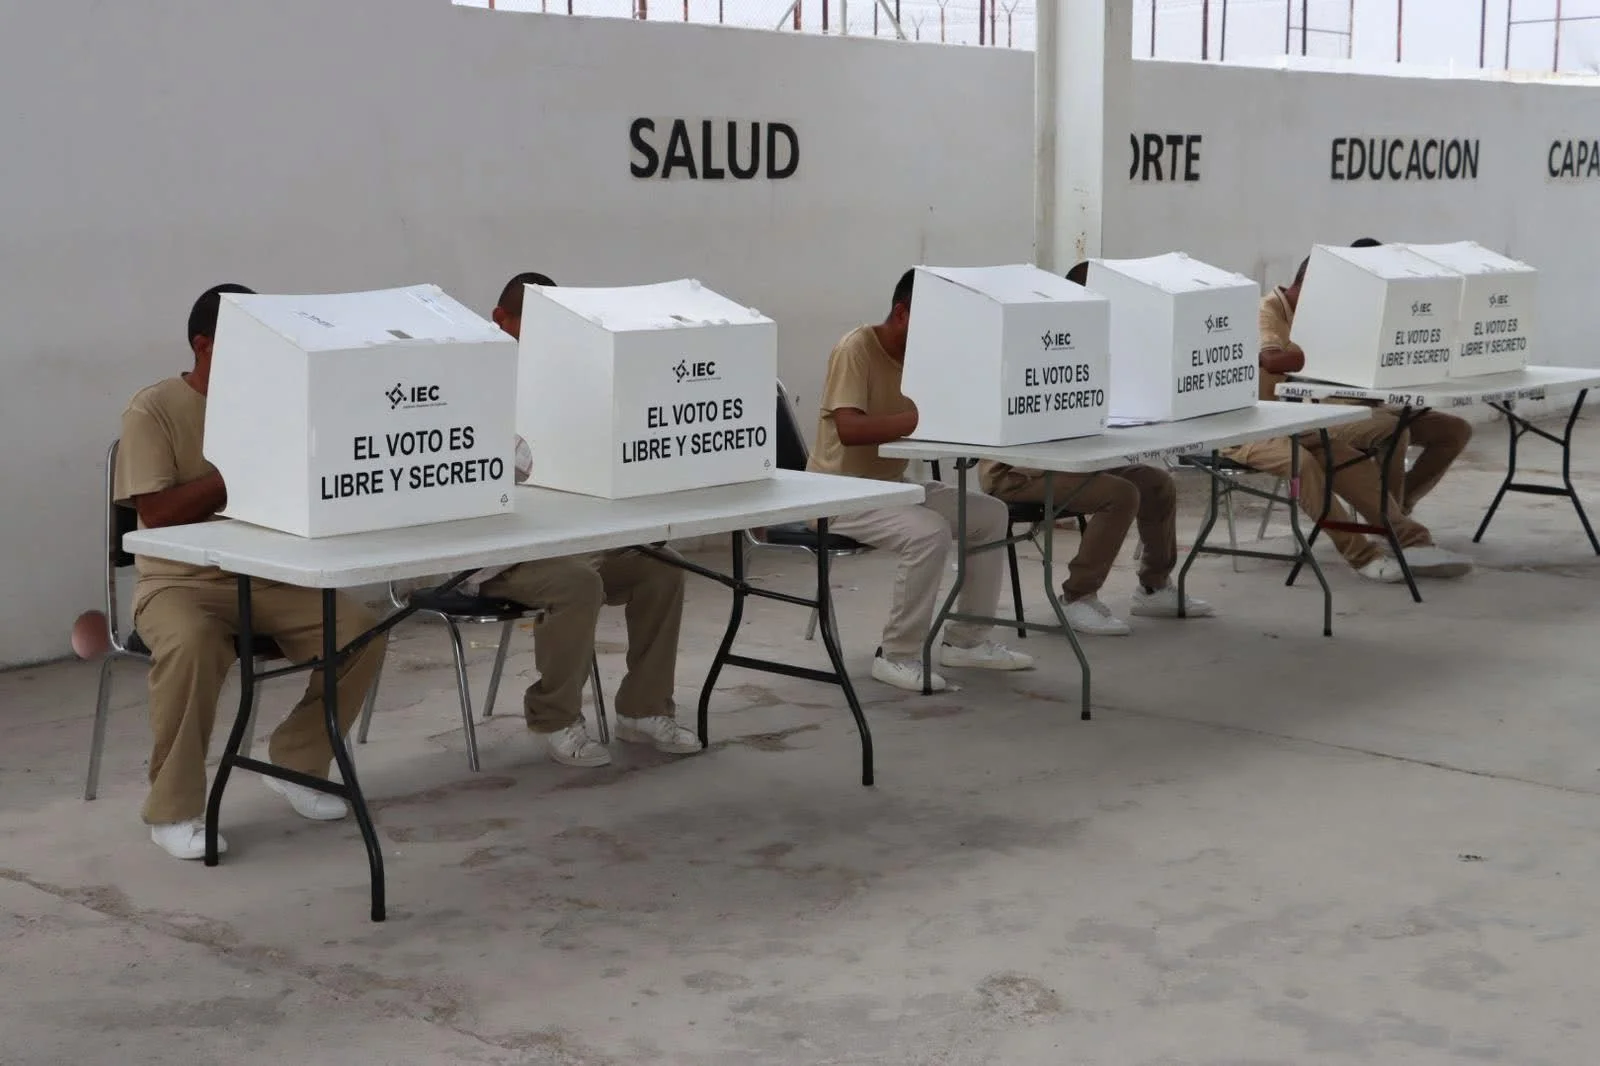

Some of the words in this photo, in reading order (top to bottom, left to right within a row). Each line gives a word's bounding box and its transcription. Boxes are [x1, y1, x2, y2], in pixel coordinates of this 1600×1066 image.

[629, 117, 800, 180] SALUD
[1330, 137, 1480, 181] EDUCACION
[1548, 140, 1600, 178] CAPA
[1419, 303, 1432, 313] IEC
[1497, 295, 1508, 304] IEC
[1215, 316, 1229, 328] IEC
[1474, 322, 1484, 336] EL
[1485, 320, 1507, 333] VOTO
[1508, 318, 1518, 331] ES
[1055, 333, 1071, 346] IEC
[1395, 331, 1406, 345] EL
[1407, 330, 1428, 344] VOTO
[1430, 328, 1441, 343] ES
[1461, 341, 1483, 356] LIBRE
[1485, 341, 1491, 353] Y
[1491, 337, 1526, 353] SECRETO
[1191, 350, 1203, 366] EL
[1205, 345, 1230, 363] VOTO
[1232, 343, 1243, 360] ES
[1380, 351, 1404, 367] LIBRE
[1406, 350, 1412, 364] Y
[1413, 349, 1449, 364] SECRETO
[692, 361, 716, 377] IEC
[1025, 368, 1039, 387] EL
[1042, 365, 1073, 386] VOTO
[1076, 364, 1090, 382] ES
[1177, 373, 1204, 393] LIBRE
[1207, 371, 1214, 387] Y
[1215, 364, 1254, 387] SECRETO
[410, 385, 440, 403] IEC
[1007, 394, 1041, 415] LIBRE
[1044, 393, 1052, 411] Y
[1053, 389, 1104, 410] SECRETO
[647, 406, 668, 428] EL
[672, 401, 718, 425] VOTO
[723, 398, 743, 420] ES
[353, 436, 380, 460] EL
[385, 430, 443, 456] VOTO
[449, 426, 474, 450] ES
[622, 437, 671, 464] LIBRE
[675, 435, 688, 456] Y
[690, 426, 767, 455] SECRETO
[320, 470, 384, 500] LIBRE
[389, 467, 404, 491] Y
[408, 457, 504, 489] SECRETO
